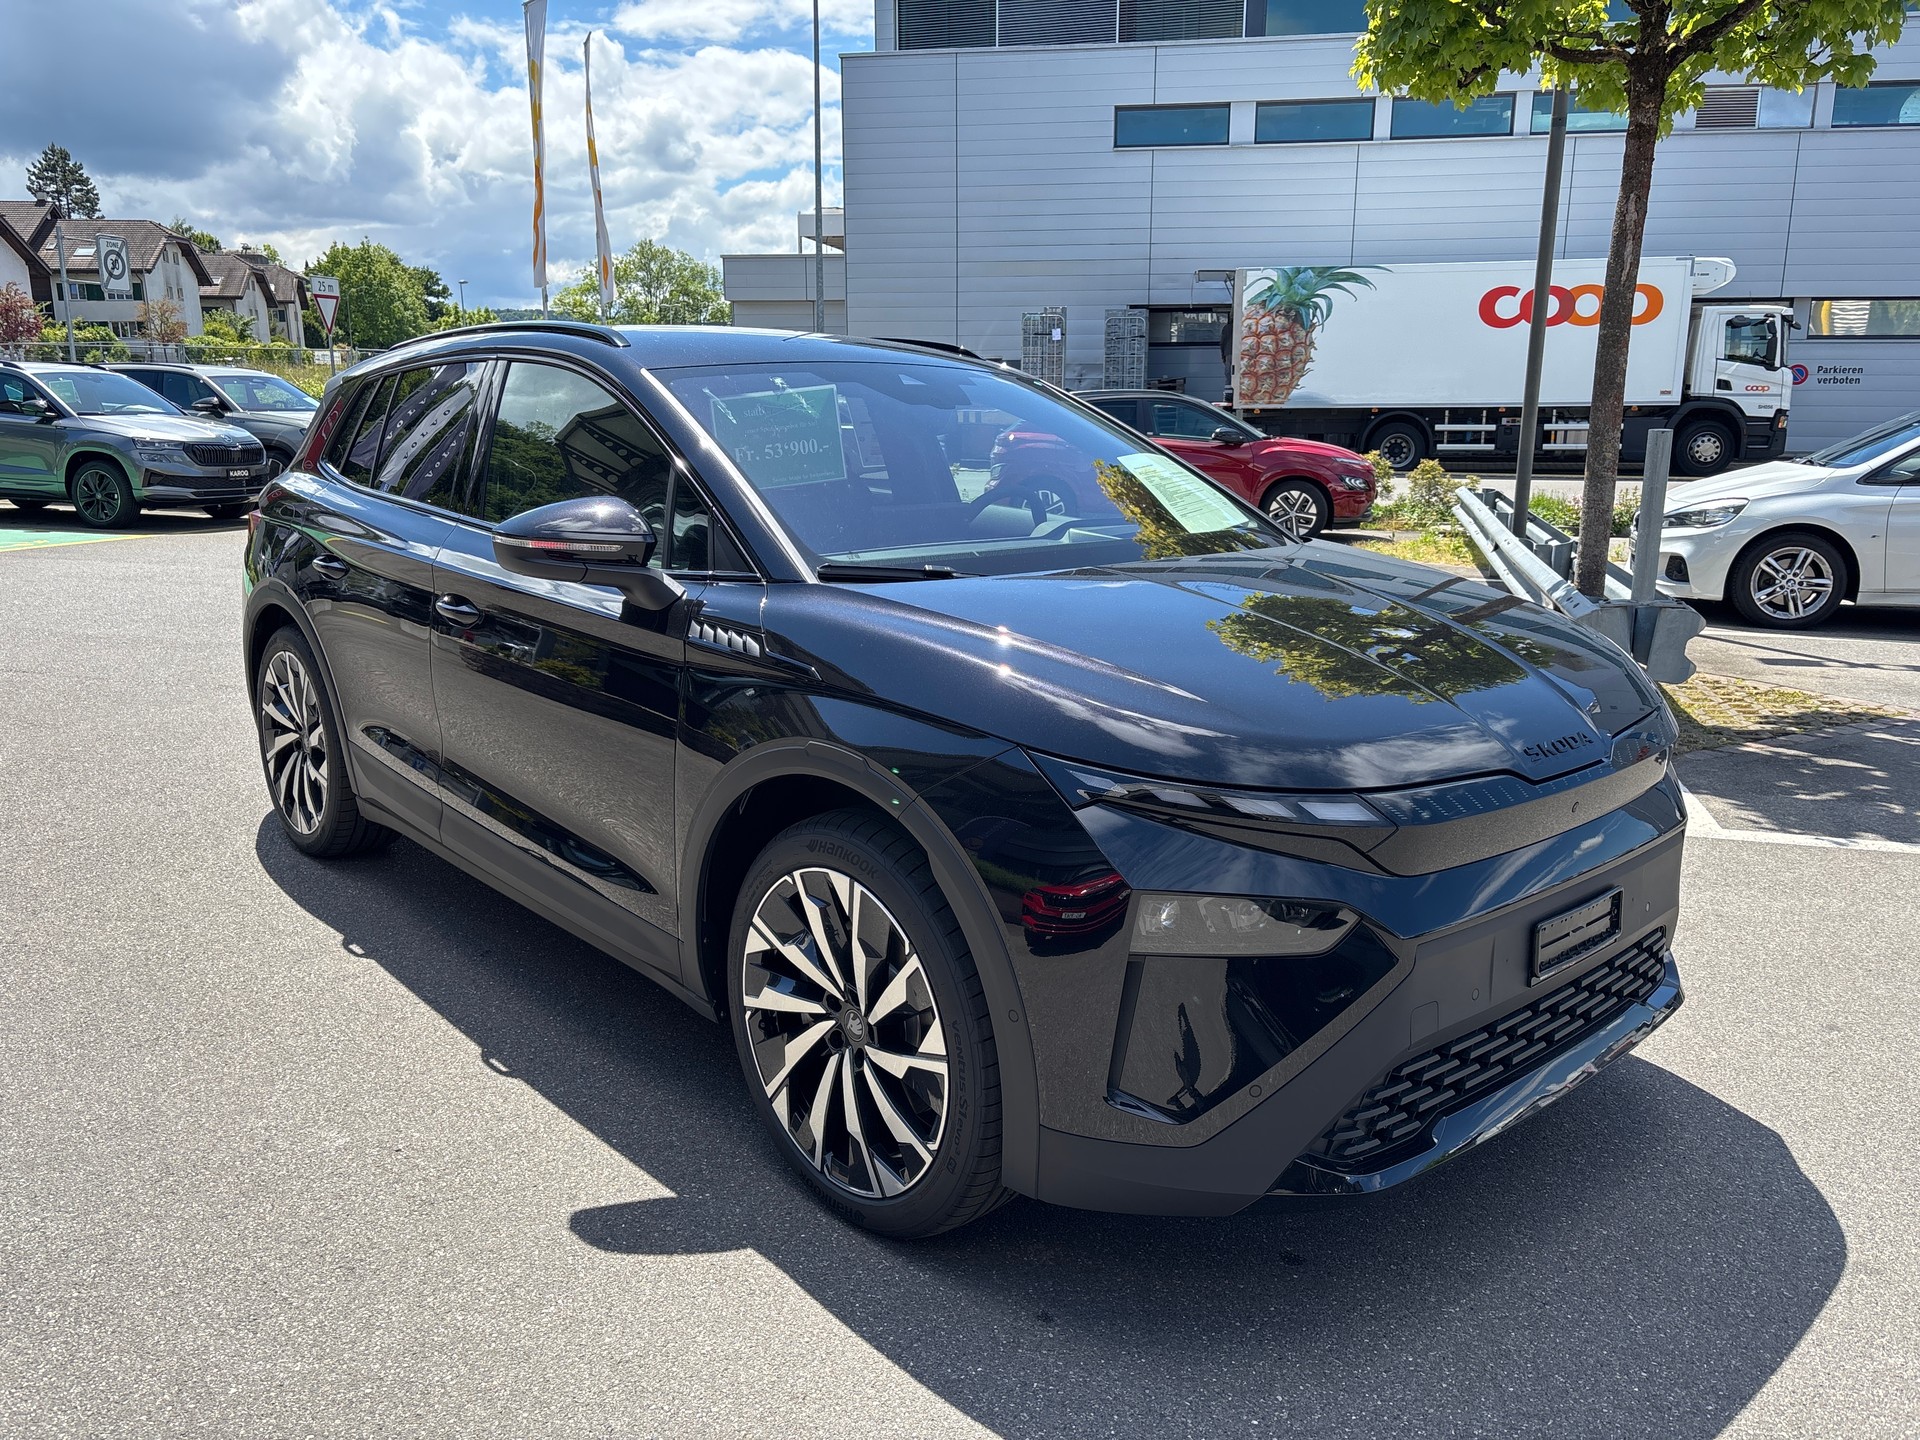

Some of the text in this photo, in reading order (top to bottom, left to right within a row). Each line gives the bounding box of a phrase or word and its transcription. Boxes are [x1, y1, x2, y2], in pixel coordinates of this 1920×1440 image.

[105, 240, 119, 249] ZONE
[110, 258, 120, 271] 30
[317, 280, 334, 292] 25 m
[1816, 365, 1864, 374] Parkieren
[1817, 376, 1861, 384] verboten
[403, 409, 451, 460] VOLVO
[734, 445, 760, 463] Fr.
[229, 469, 249, 477] KAROQ
